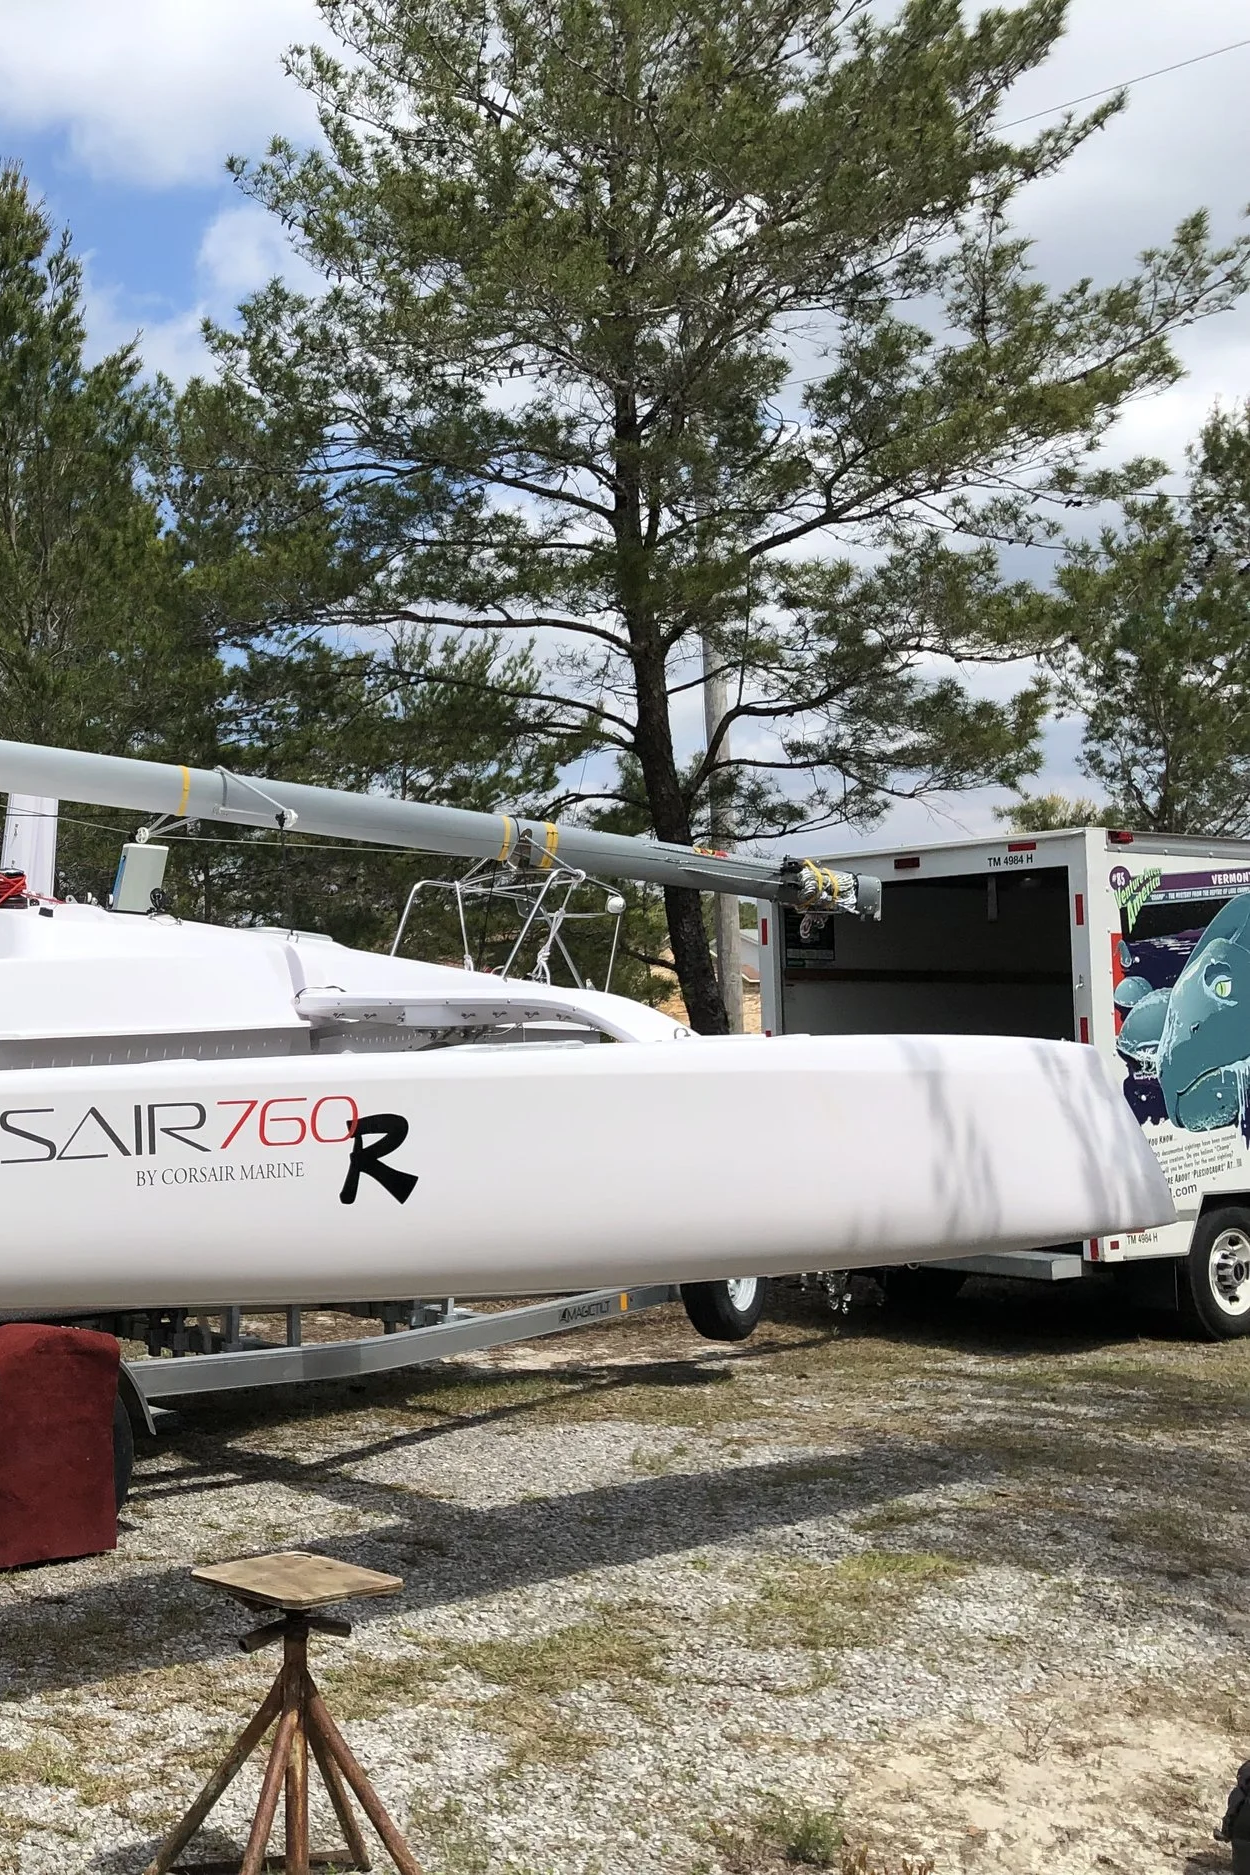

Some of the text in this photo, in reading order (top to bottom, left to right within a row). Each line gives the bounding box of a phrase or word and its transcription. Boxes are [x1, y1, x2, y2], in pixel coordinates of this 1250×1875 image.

[987, 853, 1033, 867] TM 4984 H
[1111, 872, 1126, 886] #85
[1113, 873, 1144, 910] Venture
[1127, 876, 1161, 934] America
[217, 1096, 359, 1150] 760
[339, 1113, 419, 1205] R
[136, 1161, 305, 1187] BY CORSAIR MARINE
[1175, 1172, 1191, 1183] ABOUT
[1126, 1232, 1158, 1245] TM 4984 H
